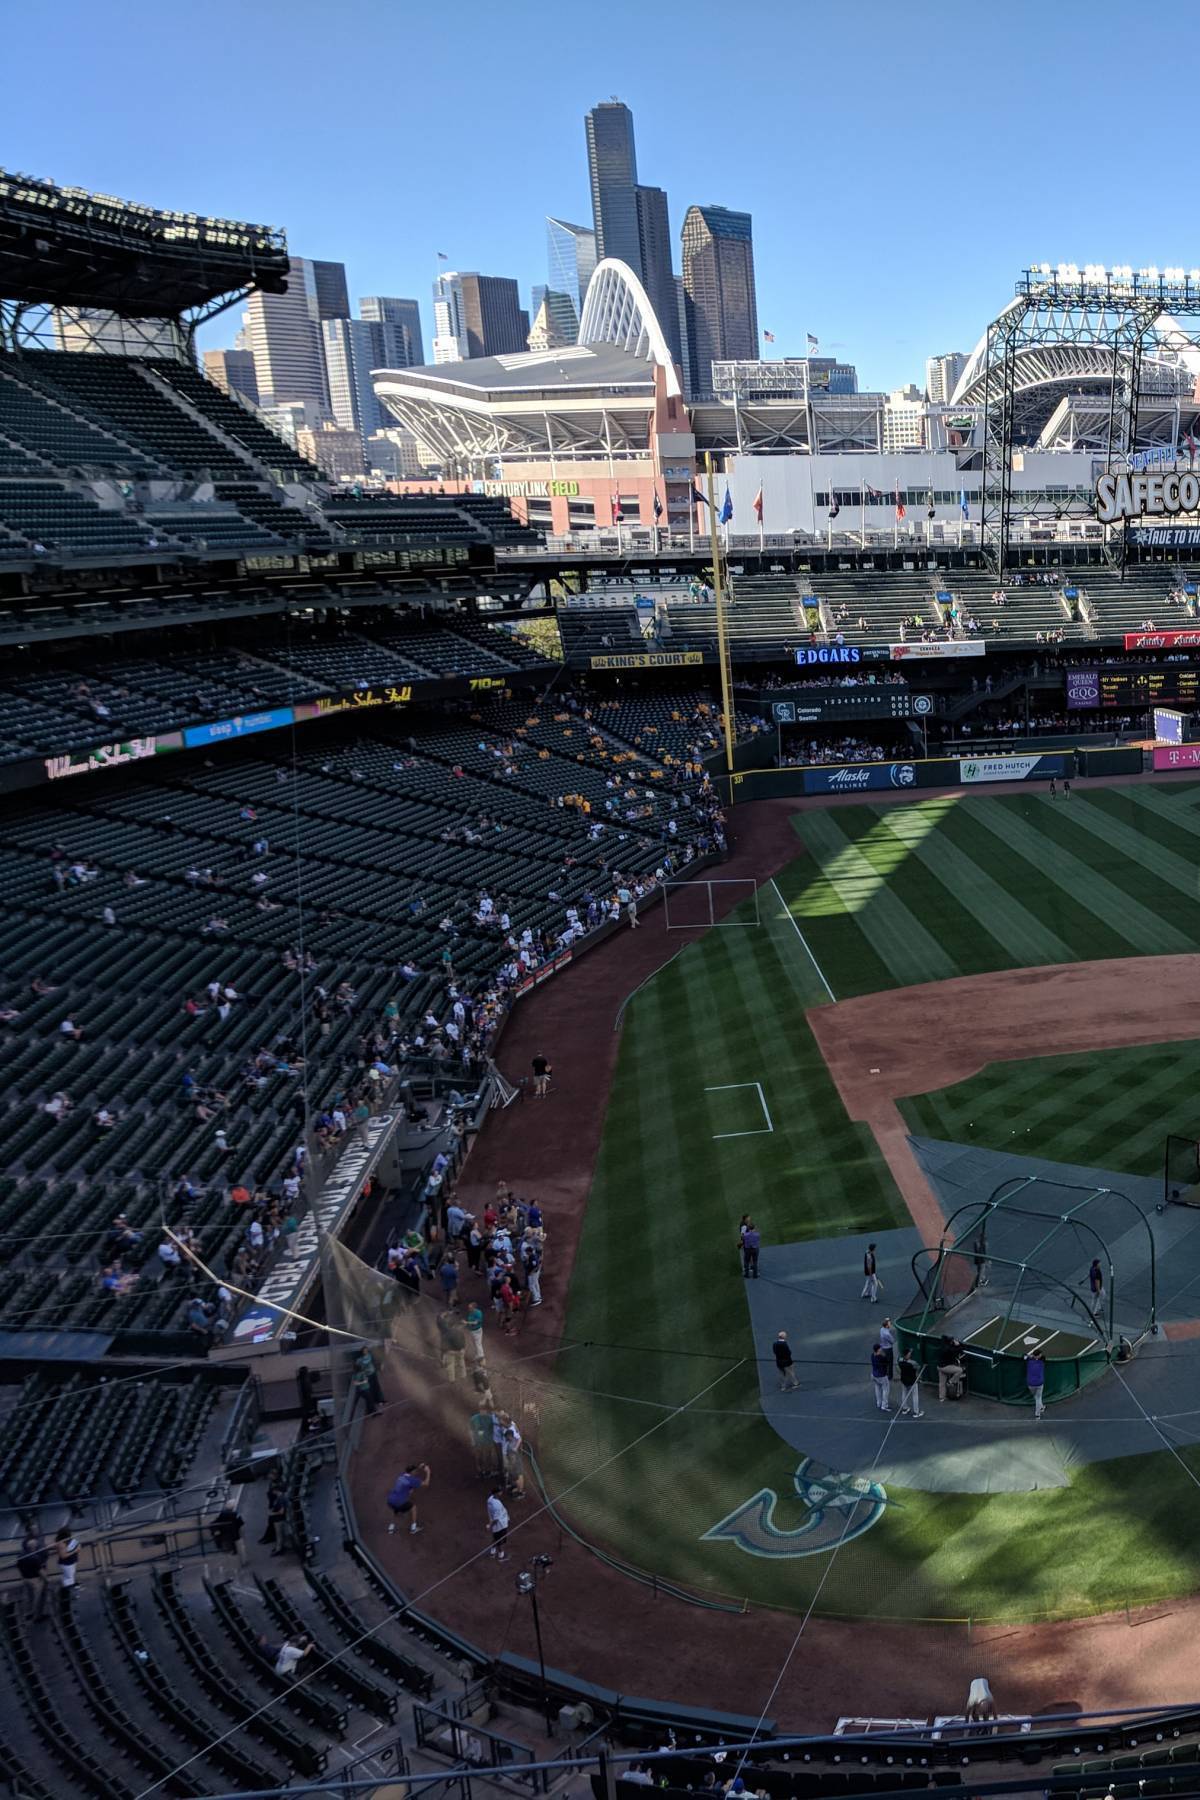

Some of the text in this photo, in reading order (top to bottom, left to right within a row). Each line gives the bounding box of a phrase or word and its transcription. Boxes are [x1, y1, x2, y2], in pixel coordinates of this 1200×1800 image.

[1127, 445, 1176, 472] SEATTLE
[484, 480, 578, 497] CENTURYLINK FIELD
[1097, 472, 1199, 523] SAFECO
[1148, 527, 1173, 544] TRUE
[1174, 529, 1187, 543] TO
[1136, 635, 1166, 647] xfinity
[607, 654, 687, 668] KING'S COURT
[1068, 673, 1098, 681] EMERALD
[828, 769, 869, 782] Alaska
[255, 1259, 311, 1302] FIELD
